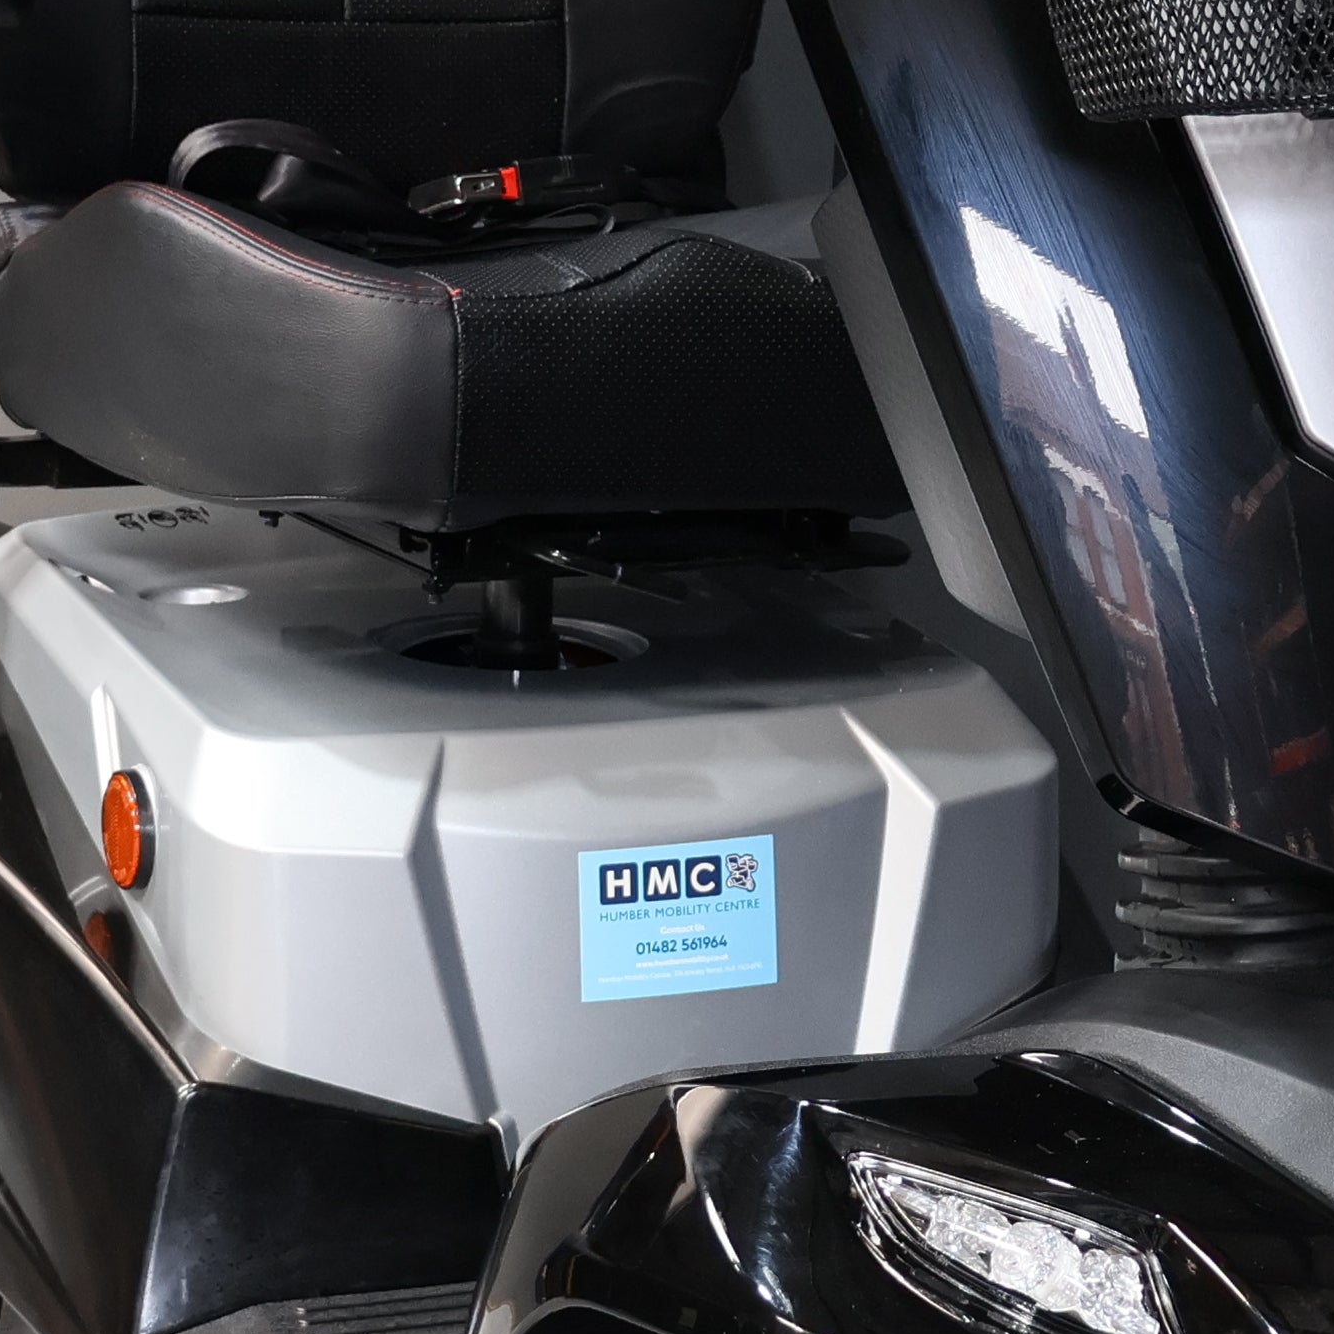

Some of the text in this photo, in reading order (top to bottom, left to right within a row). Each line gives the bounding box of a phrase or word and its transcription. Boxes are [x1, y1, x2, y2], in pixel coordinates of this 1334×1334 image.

[605, 861, 716, 899] HMC
[599, 898, 760, 922] HUMBER MOBILITY CENTRE
[635, 934, 728, 955] 01482 561964
